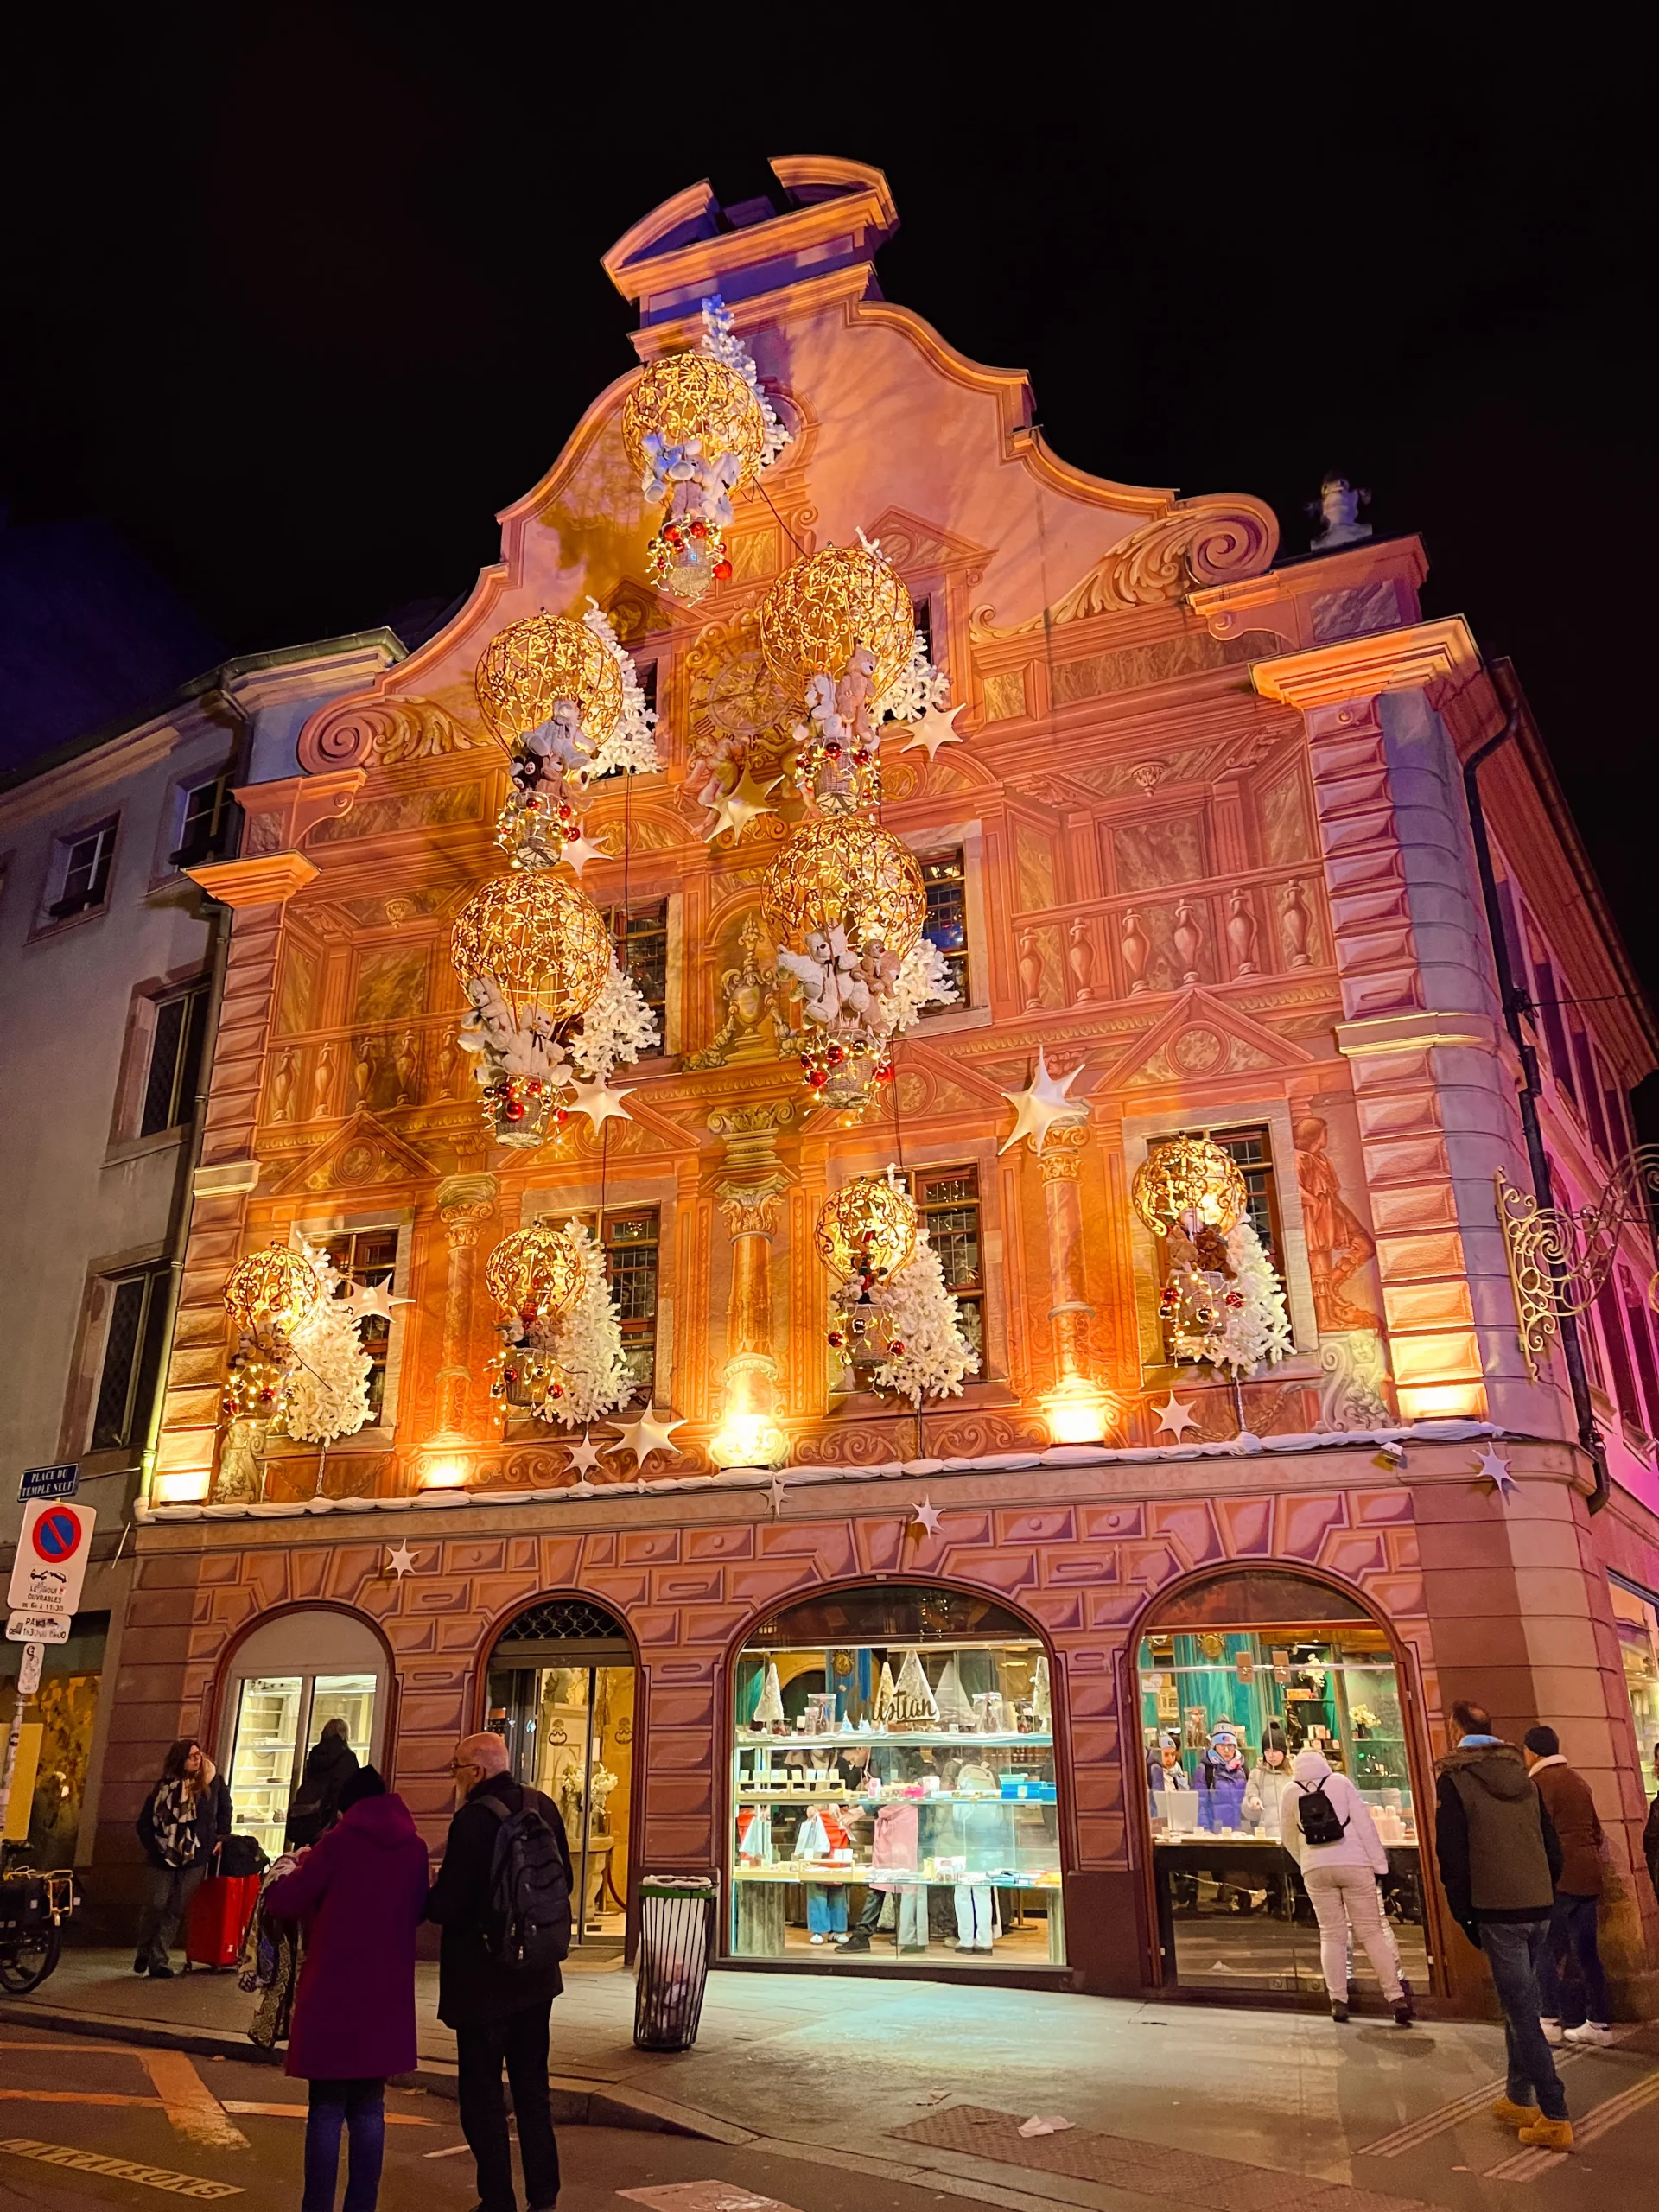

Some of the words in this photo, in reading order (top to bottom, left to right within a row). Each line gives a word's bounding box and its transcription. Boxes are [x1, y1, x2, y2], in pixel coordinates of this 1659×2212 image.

[31, 1471, 56, 1483] PLACE
[57, 1469, 68, 1478] DU
[22, 1484, 52, 1497] TEMPLE
[53, 1481, 73, 1492] NEUF
[28, 1593, 62, 1604] OUVRABLES
[2, 2139, 231, 2196] LIVRAISONS
